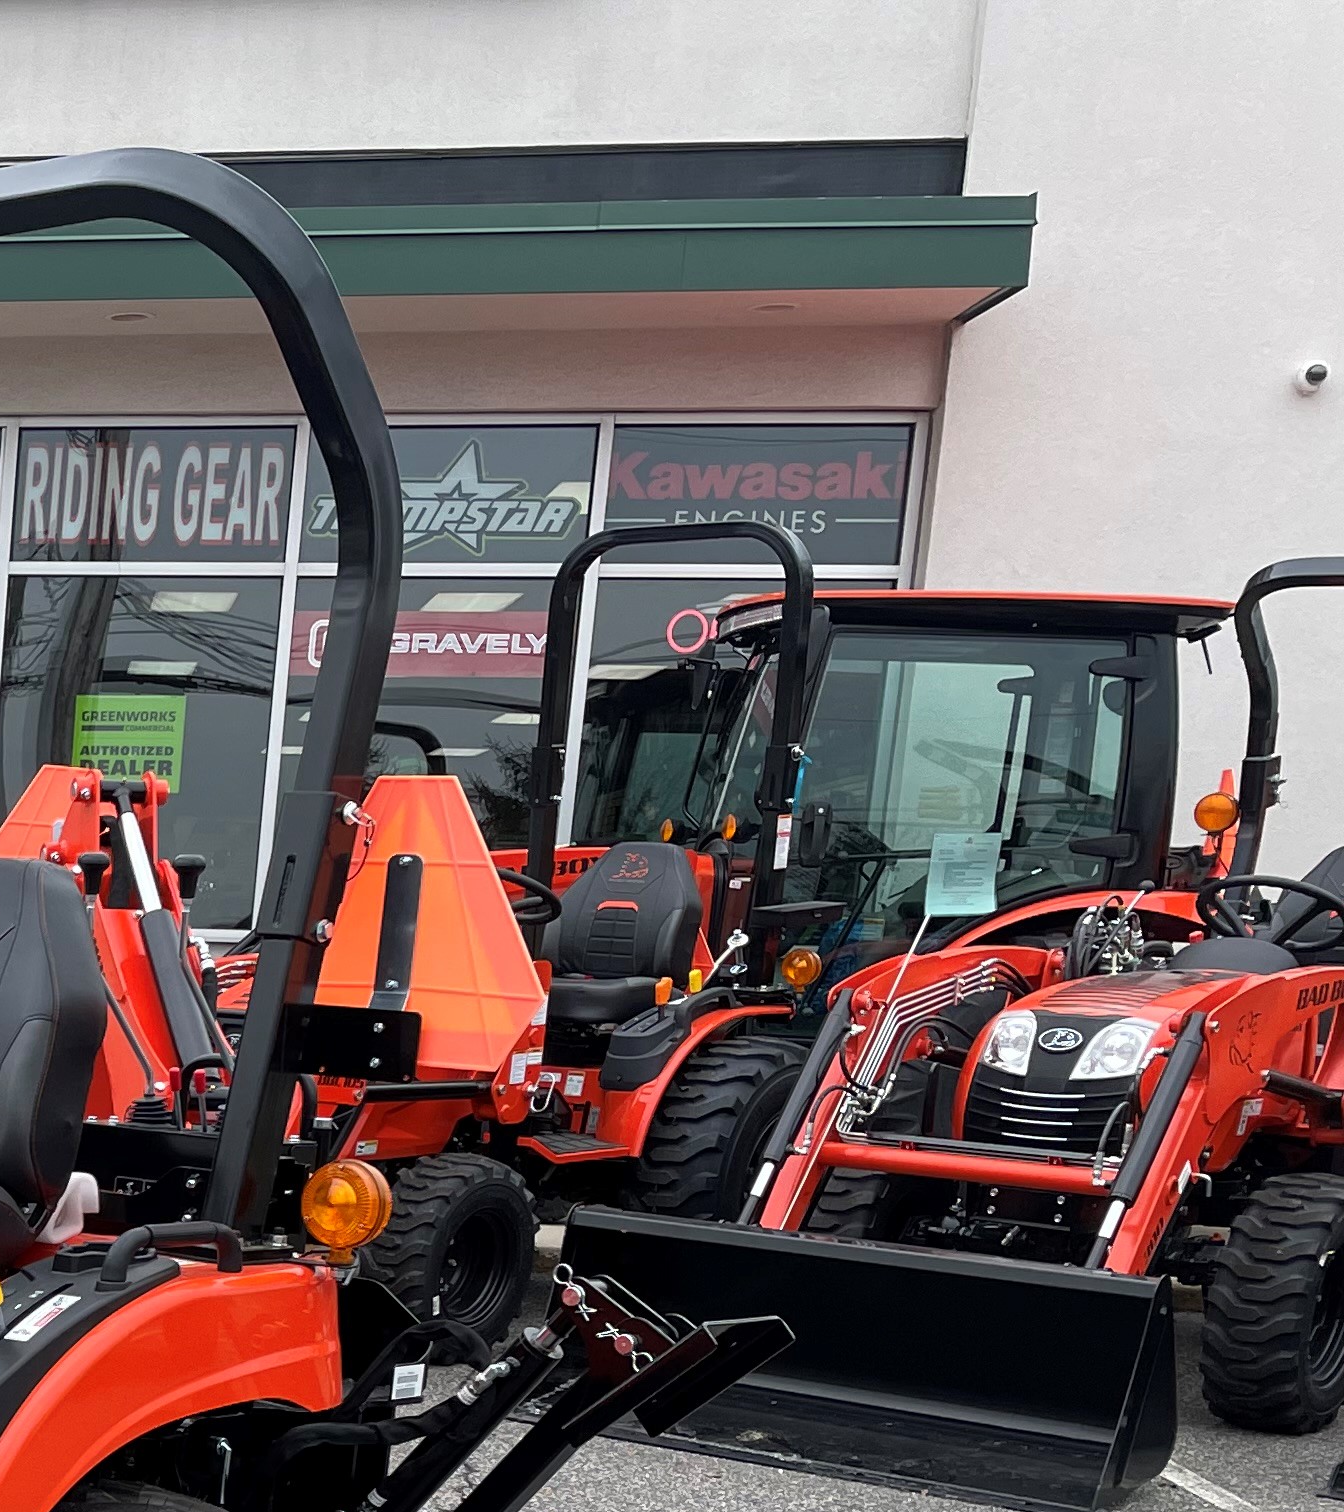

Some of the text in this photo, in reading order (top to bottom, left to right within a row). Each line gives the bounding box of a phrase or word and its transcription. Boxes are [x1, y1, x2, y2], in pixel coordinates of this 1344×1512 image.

[611, 450, 909, 501] Kawasaki
[20, 441, 286, 546] RIDING GEAR
[311, 499, 574, 534] TMPSTAR
[389, 632, 547, 654] GRAVELY
[81, 710, 177, 722] GREENWORKS
[80, 745, 174, 756] AUTHORIZED
[79, 759, 173, 776] DEALER
[1295, 982, 1330, 1012] BAD
